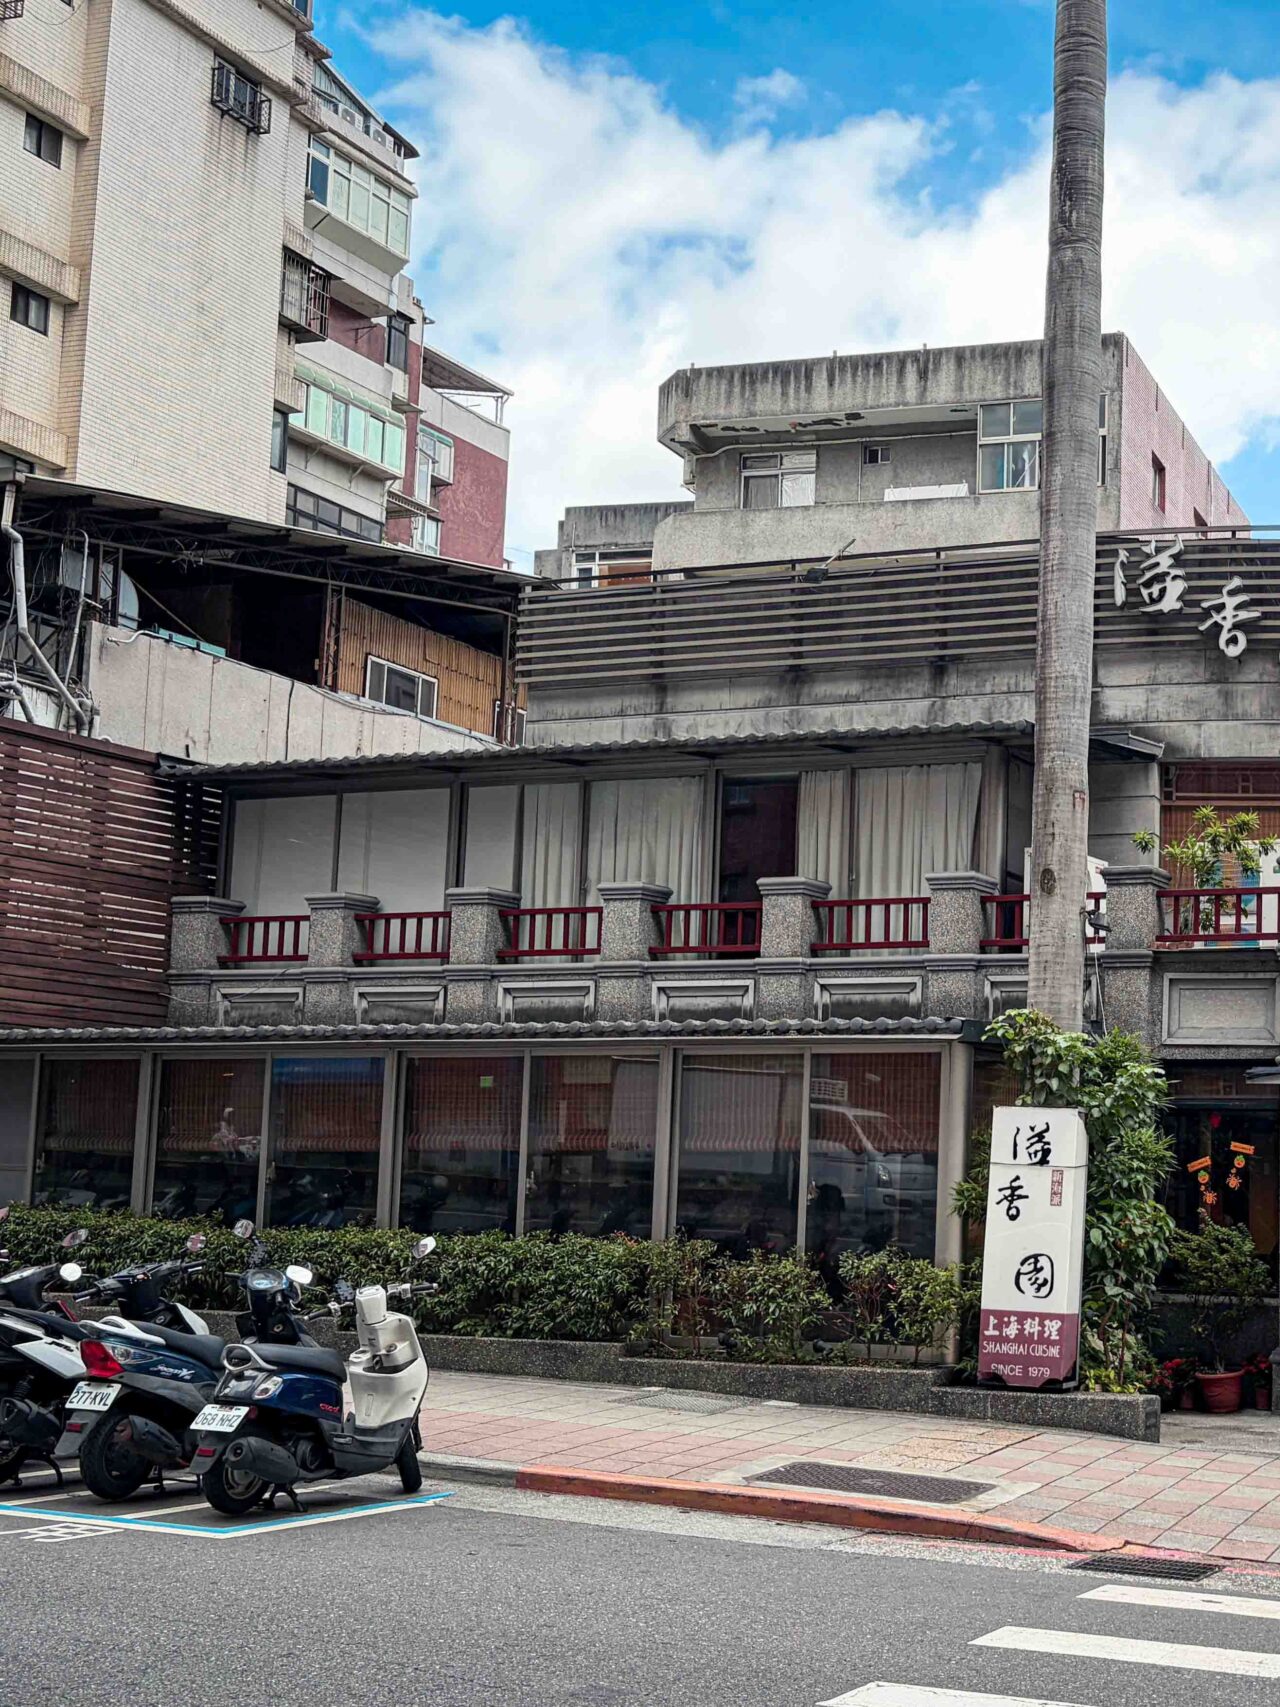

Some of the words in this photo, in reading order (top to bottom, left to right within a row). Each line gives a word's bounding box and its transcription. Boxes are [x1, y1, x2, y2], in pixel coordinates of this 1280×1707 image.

[996, 1122, 1054, 1298] 溢香園
[983, 1315, 1062, 1340] 上海料理
[982, 1341, 1027, 1355] SHANGHAI
[1029, 1344, 1060, 1357] CUISINE
[991, 1363, 1023, 1376] SINCE
[1028, 1366, 1050, 1378] 1979
